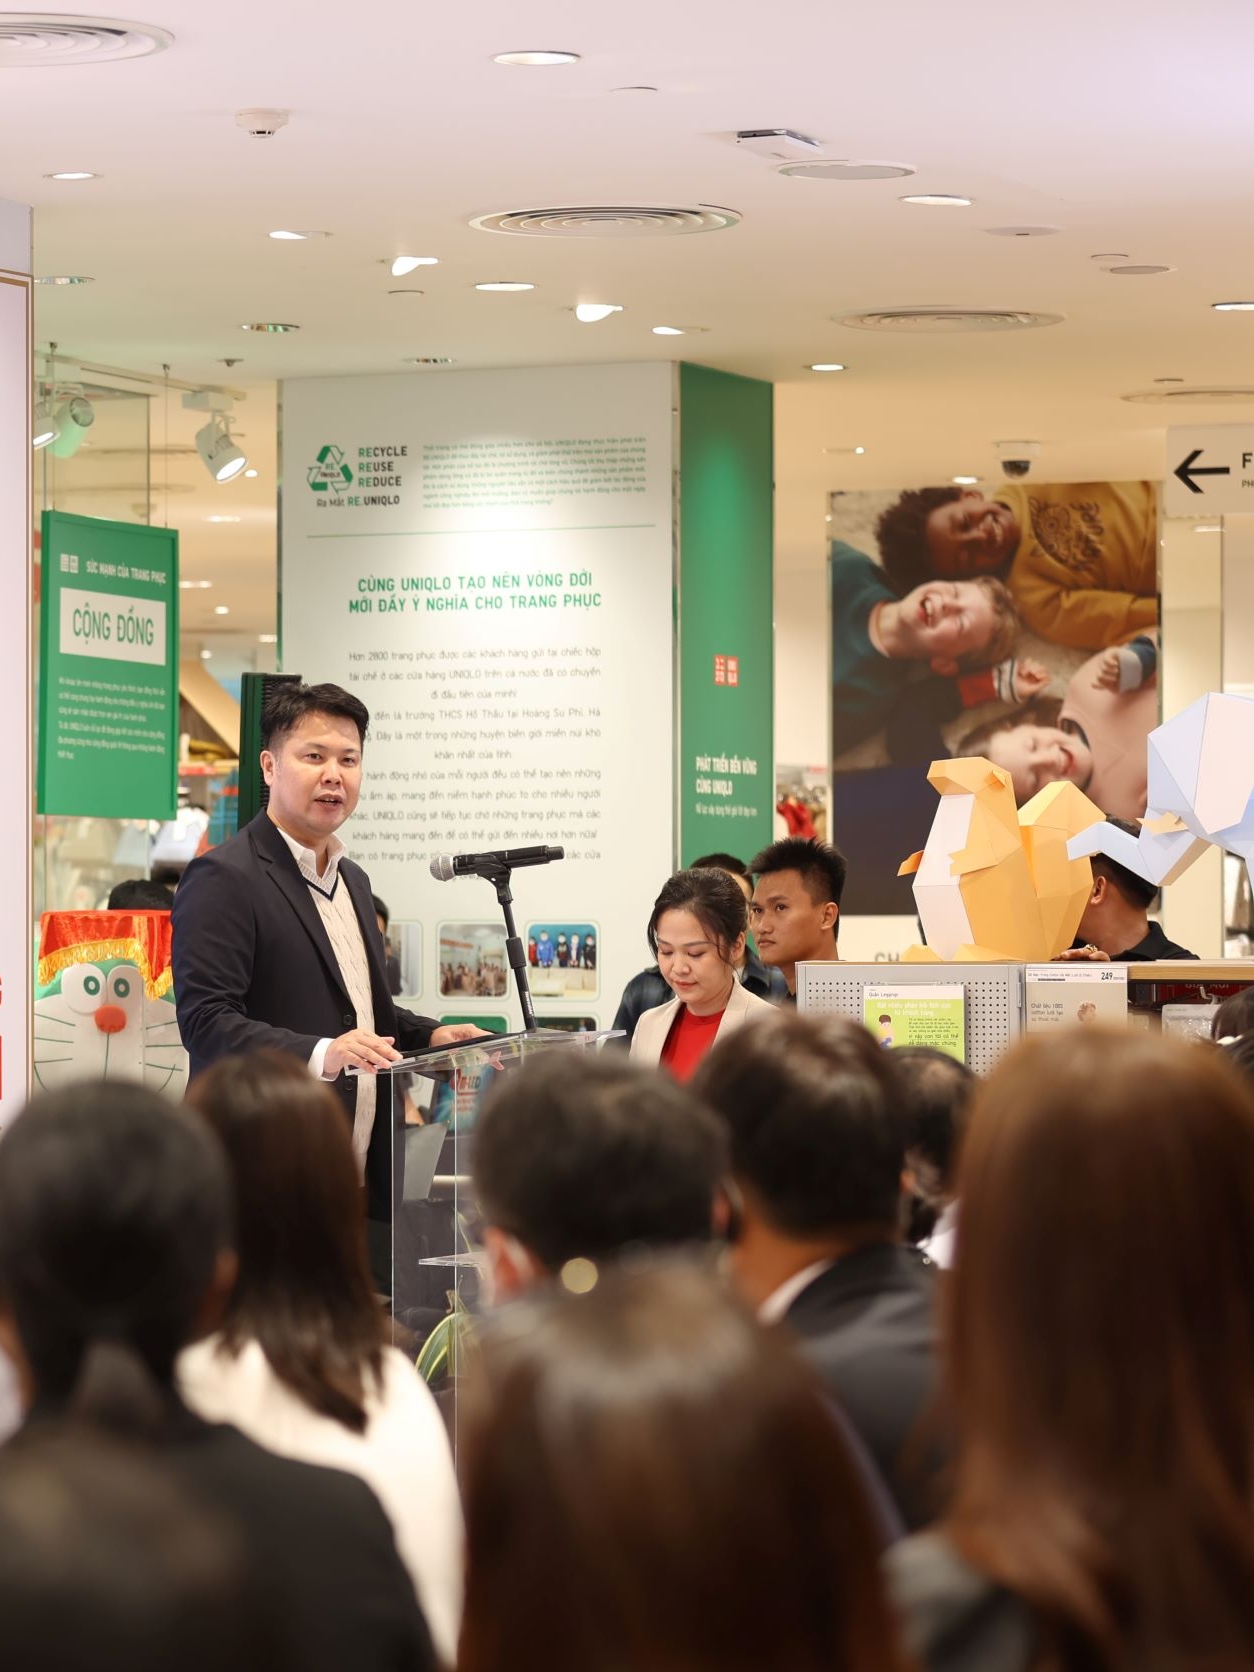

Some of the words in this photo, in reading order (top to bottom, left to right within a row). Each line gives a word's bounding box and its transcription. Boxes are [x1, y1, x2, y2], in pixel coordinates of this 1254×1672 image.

[358, 446, 408, 458] RECYCLE
[358, 461, 394, 472] REUSE
[358, 476, 402, 487] REDUCE
[401, 577, 451, 592] UNIQLO
[475, 597, 503, 610] CHO
[509, 595, 557, 609] TRANG
[73, 602, 111, 645] CỘNG
